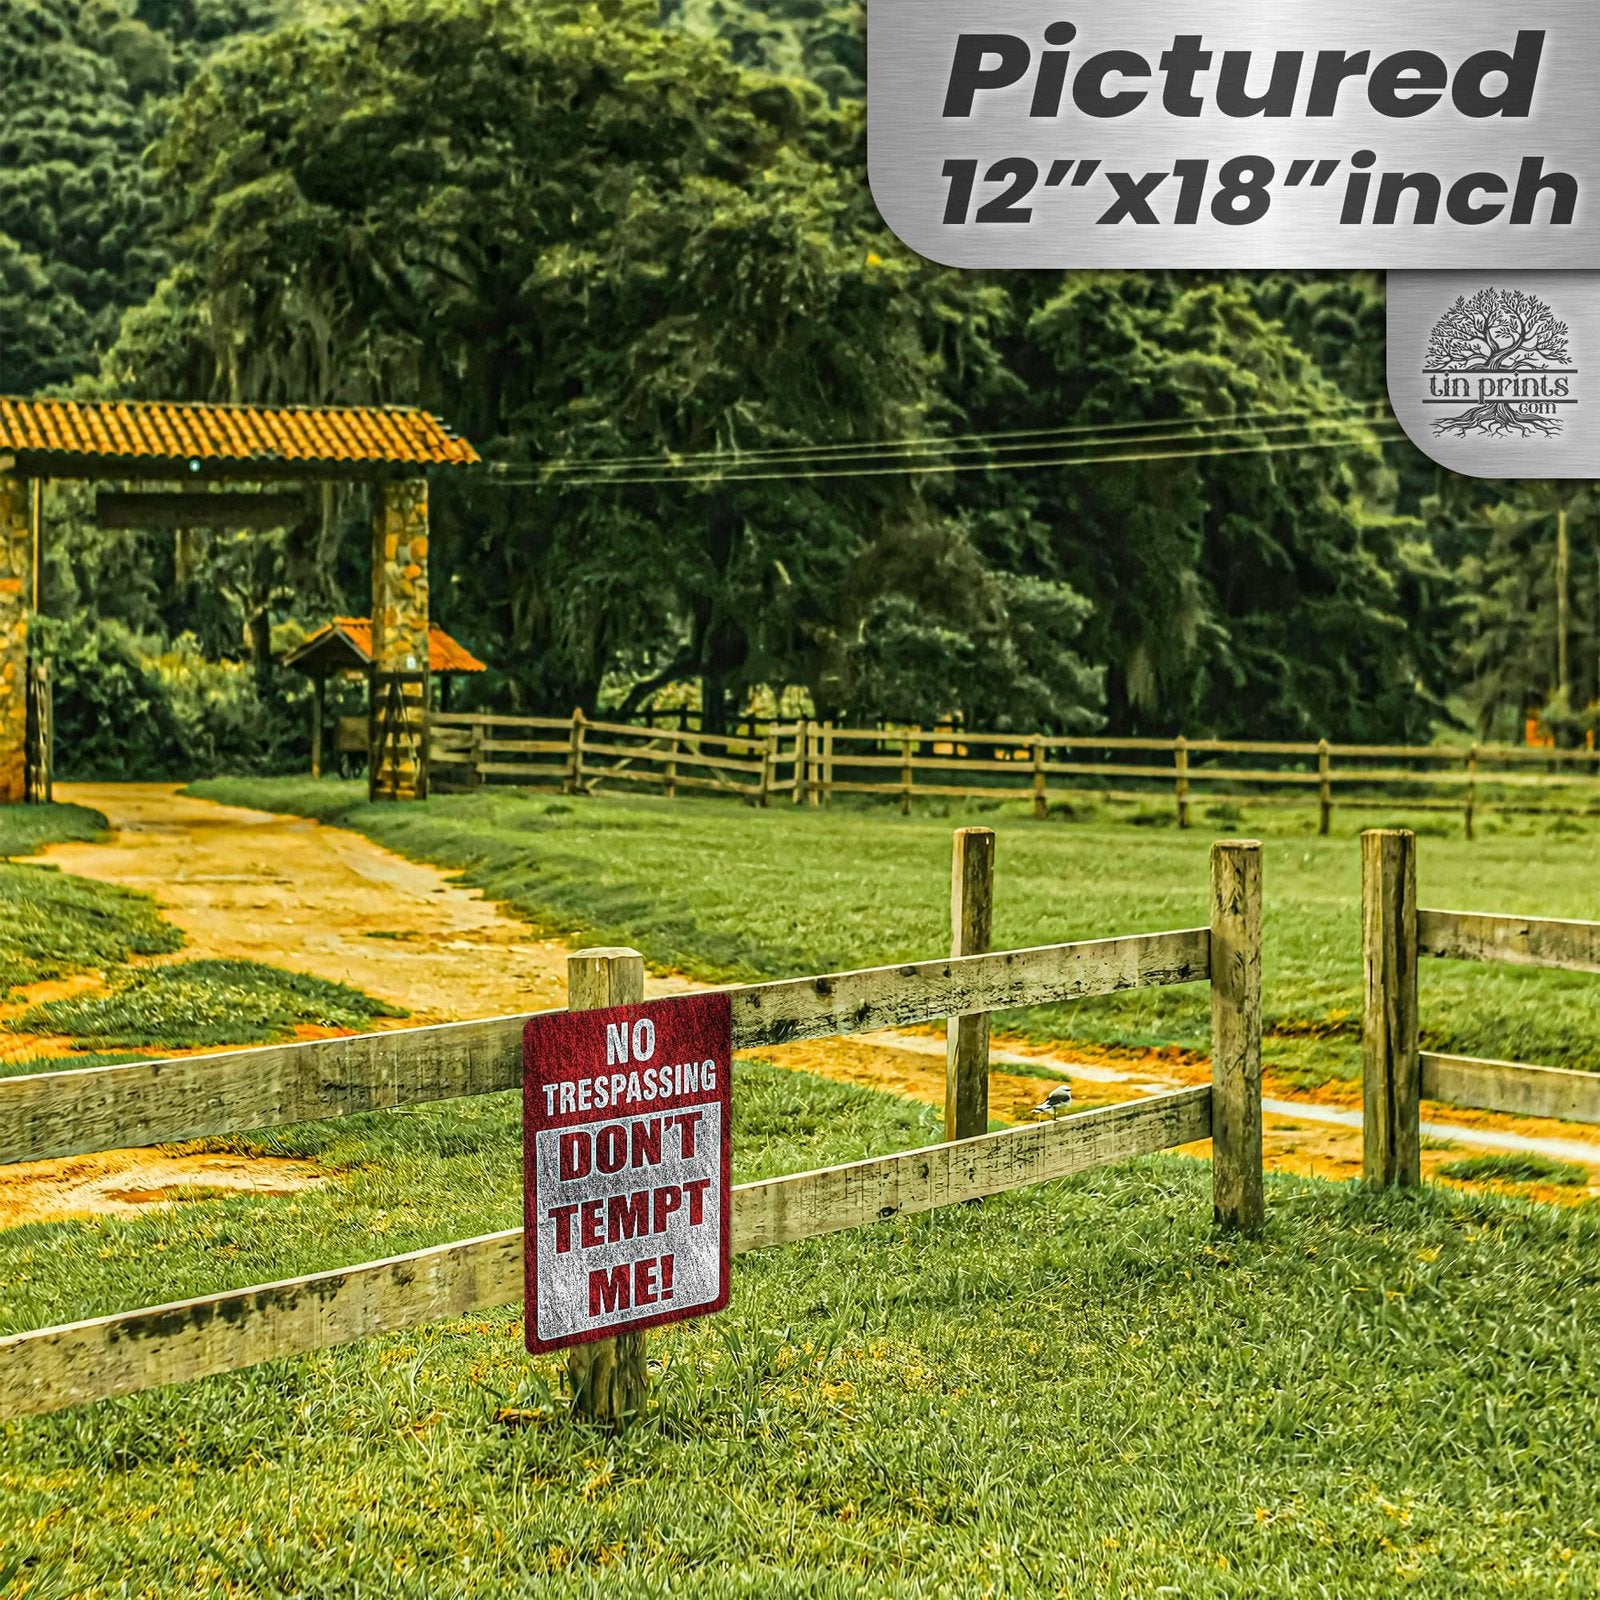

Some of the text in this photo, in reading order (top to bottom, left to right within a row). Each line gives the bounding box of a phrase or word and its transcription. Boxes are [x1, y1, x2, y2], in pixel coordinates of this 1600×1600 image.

[606, 1018, 656, 1065] NO
[542, 1059, 717, 1116] TRESPASSING
[558, 1111, 703, 1182] DON'T
[548, 1178, 711, 1255] TEMPT
[588, 1253, 675, 1319] ME!
